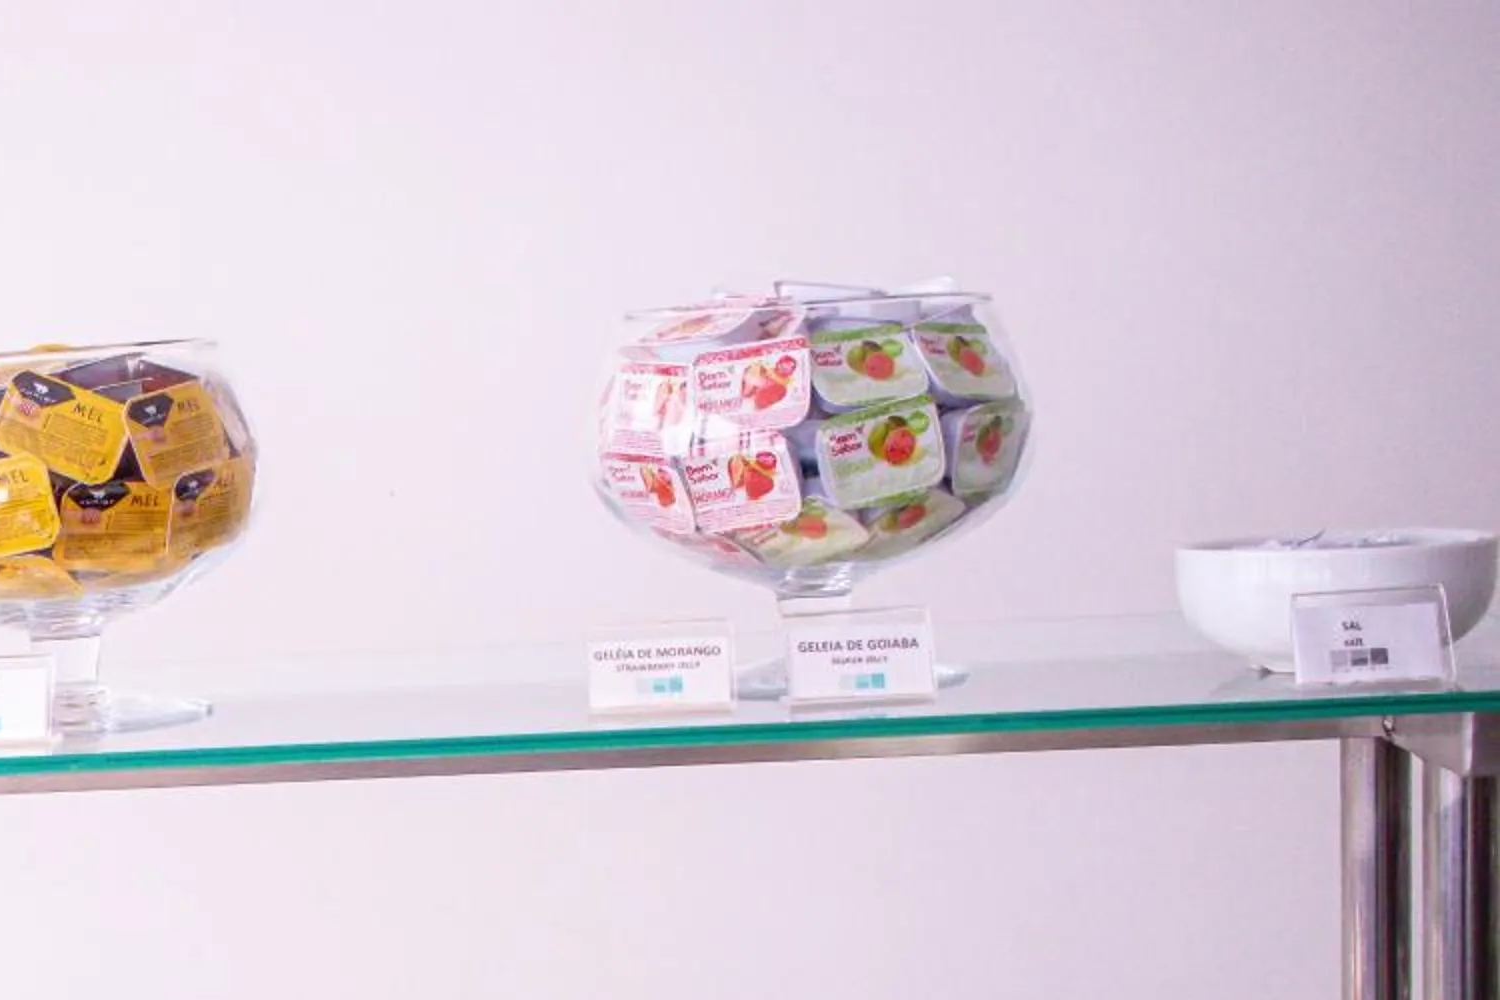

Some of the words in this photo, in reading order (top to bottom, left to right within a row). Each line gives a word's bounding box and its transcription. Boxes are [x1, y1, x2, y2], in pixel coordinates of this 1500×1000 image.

[73, 402, 103, 423] MEL
[1341, 621, 1363, 631] SAL
[637, 648, 653, 660] DE
[655, 645, 722, 658] MORANGO
[797, 641, 844, 653] GELEIA
[845, 640, 864, 650] DE
[867, 637, 920, 650] GOIABA
